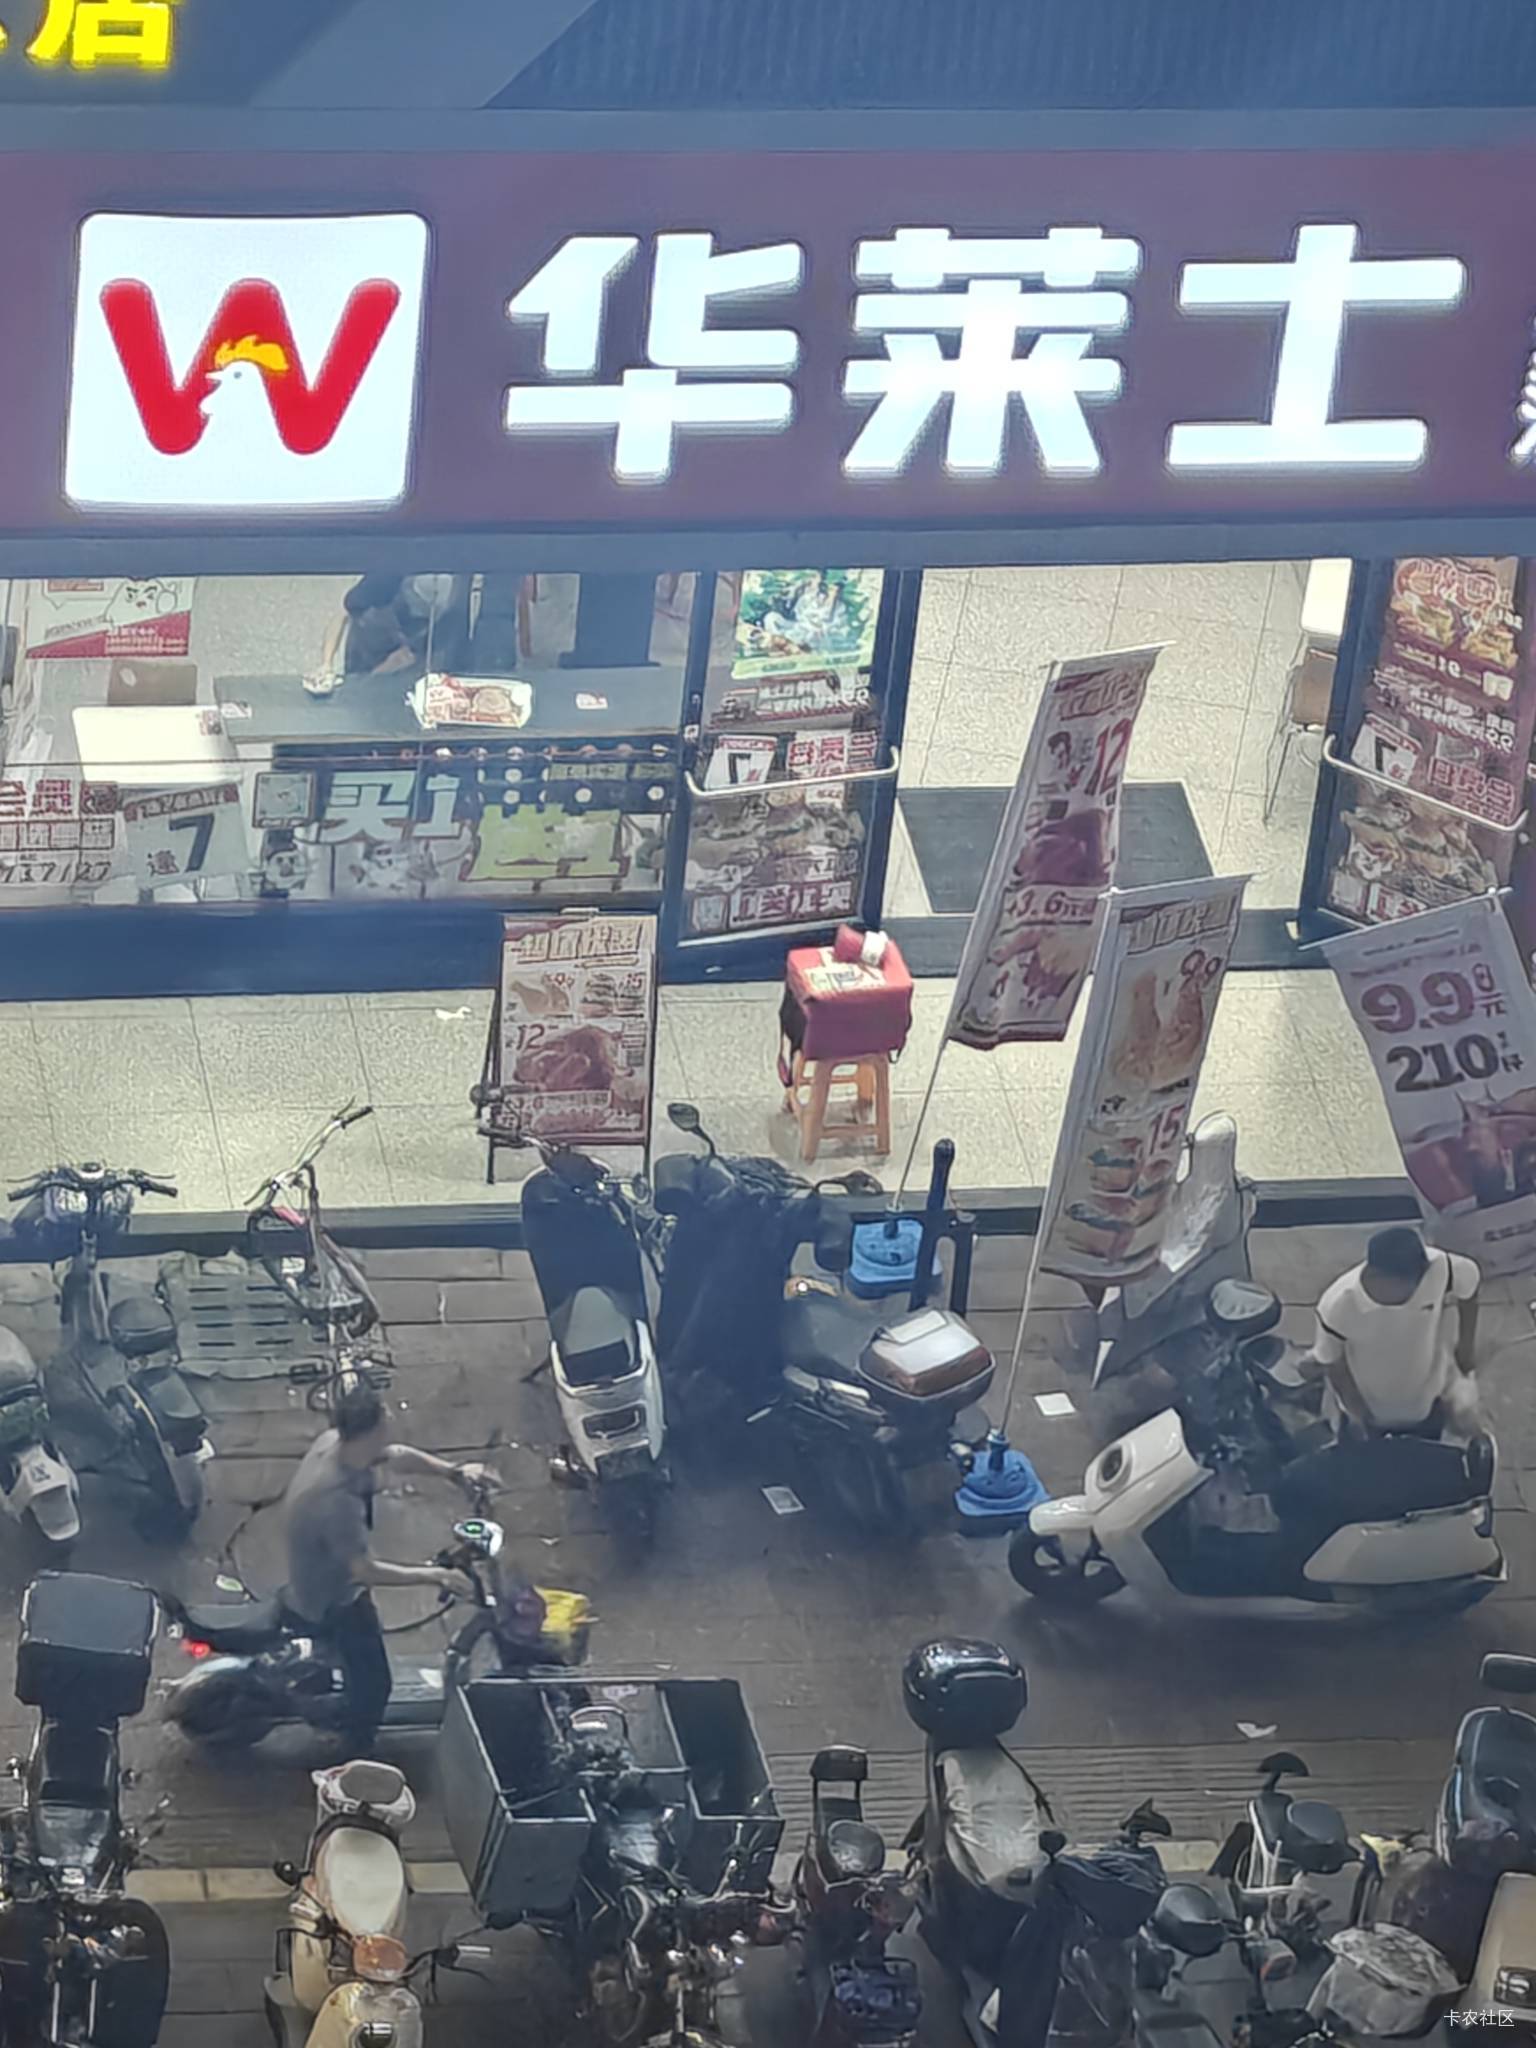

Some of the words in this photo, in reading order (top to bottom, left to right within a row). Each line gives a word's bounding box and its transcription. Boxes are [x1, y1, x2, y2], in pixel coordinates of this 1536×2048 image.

[503, 222, 1468, 486] 华莱士
[169, 813, 215, 873] 7
[1360, 970, 1476, 1034] 9.9
[1386, 1033, 1499, 1093] 210
